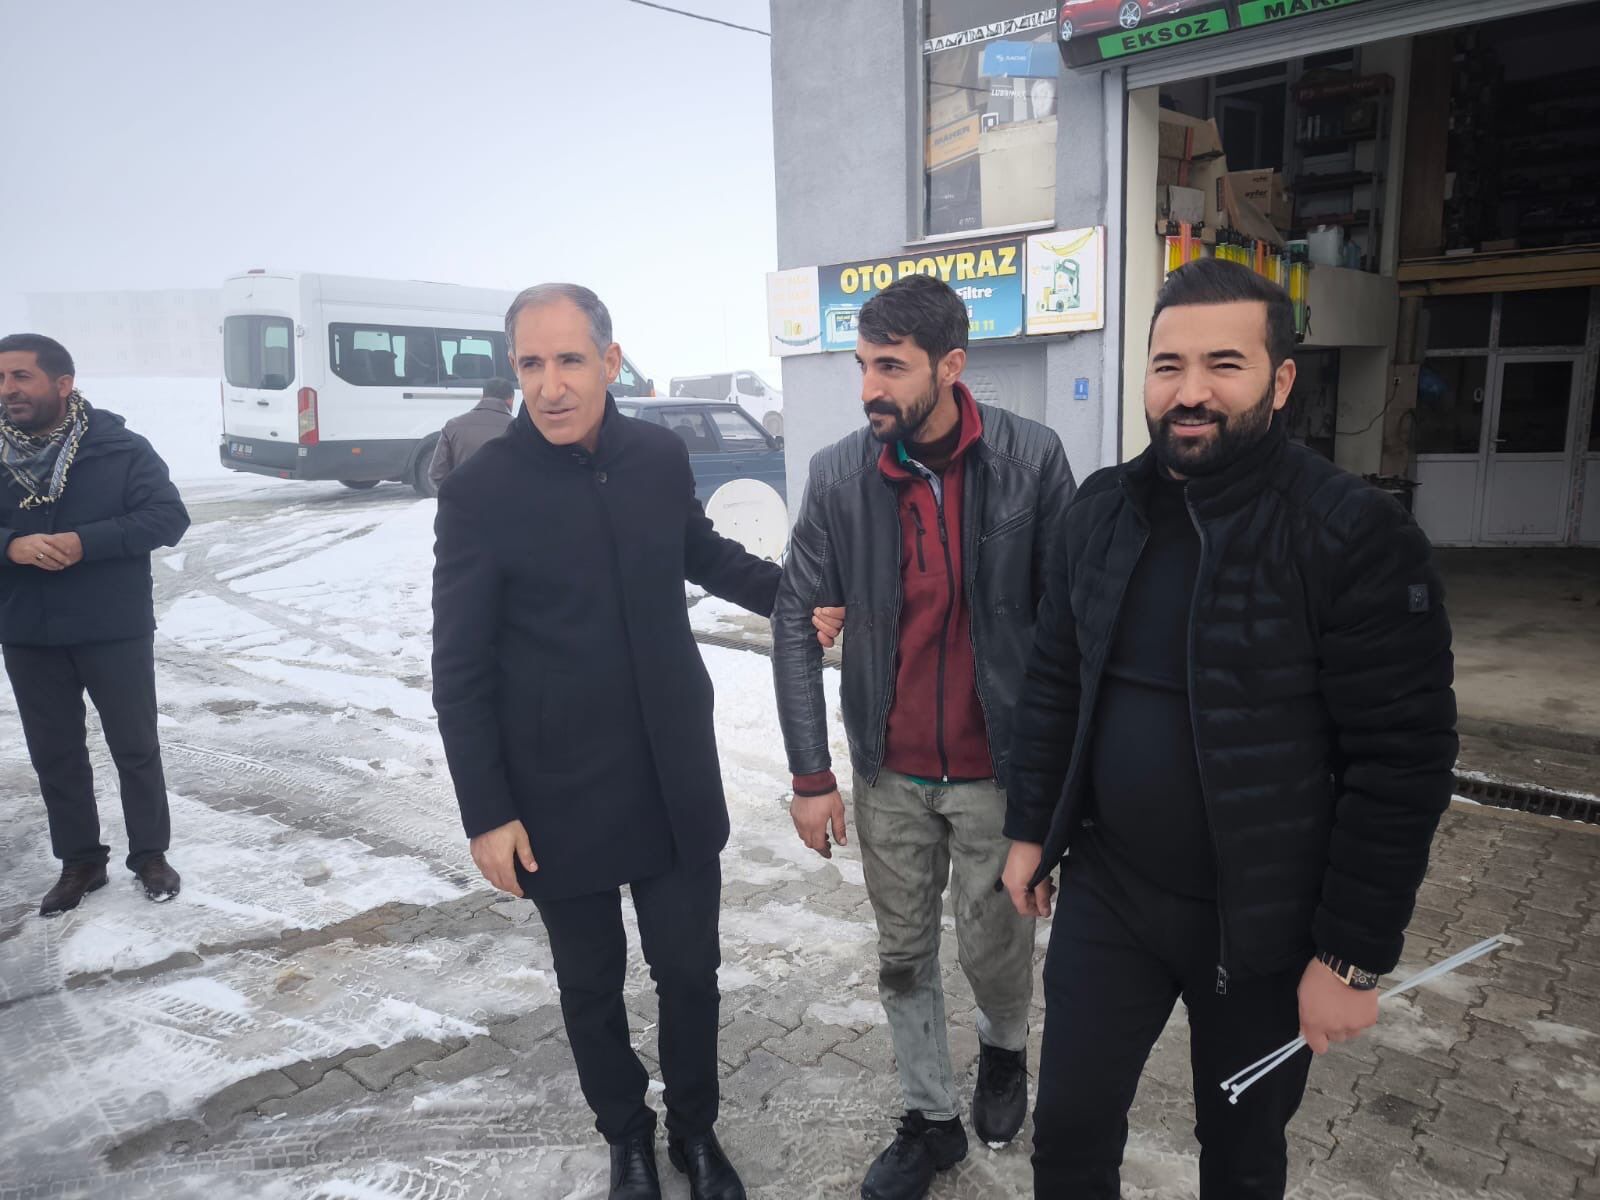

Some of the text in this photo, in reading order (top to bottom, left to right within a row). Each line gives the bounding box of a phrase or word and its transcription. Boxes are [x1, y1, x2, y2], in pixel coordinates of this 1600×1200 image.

[1121, 18, 1211, 51] EKSOZ
[840, 246, 1017, 295] OTO POYRAZ
